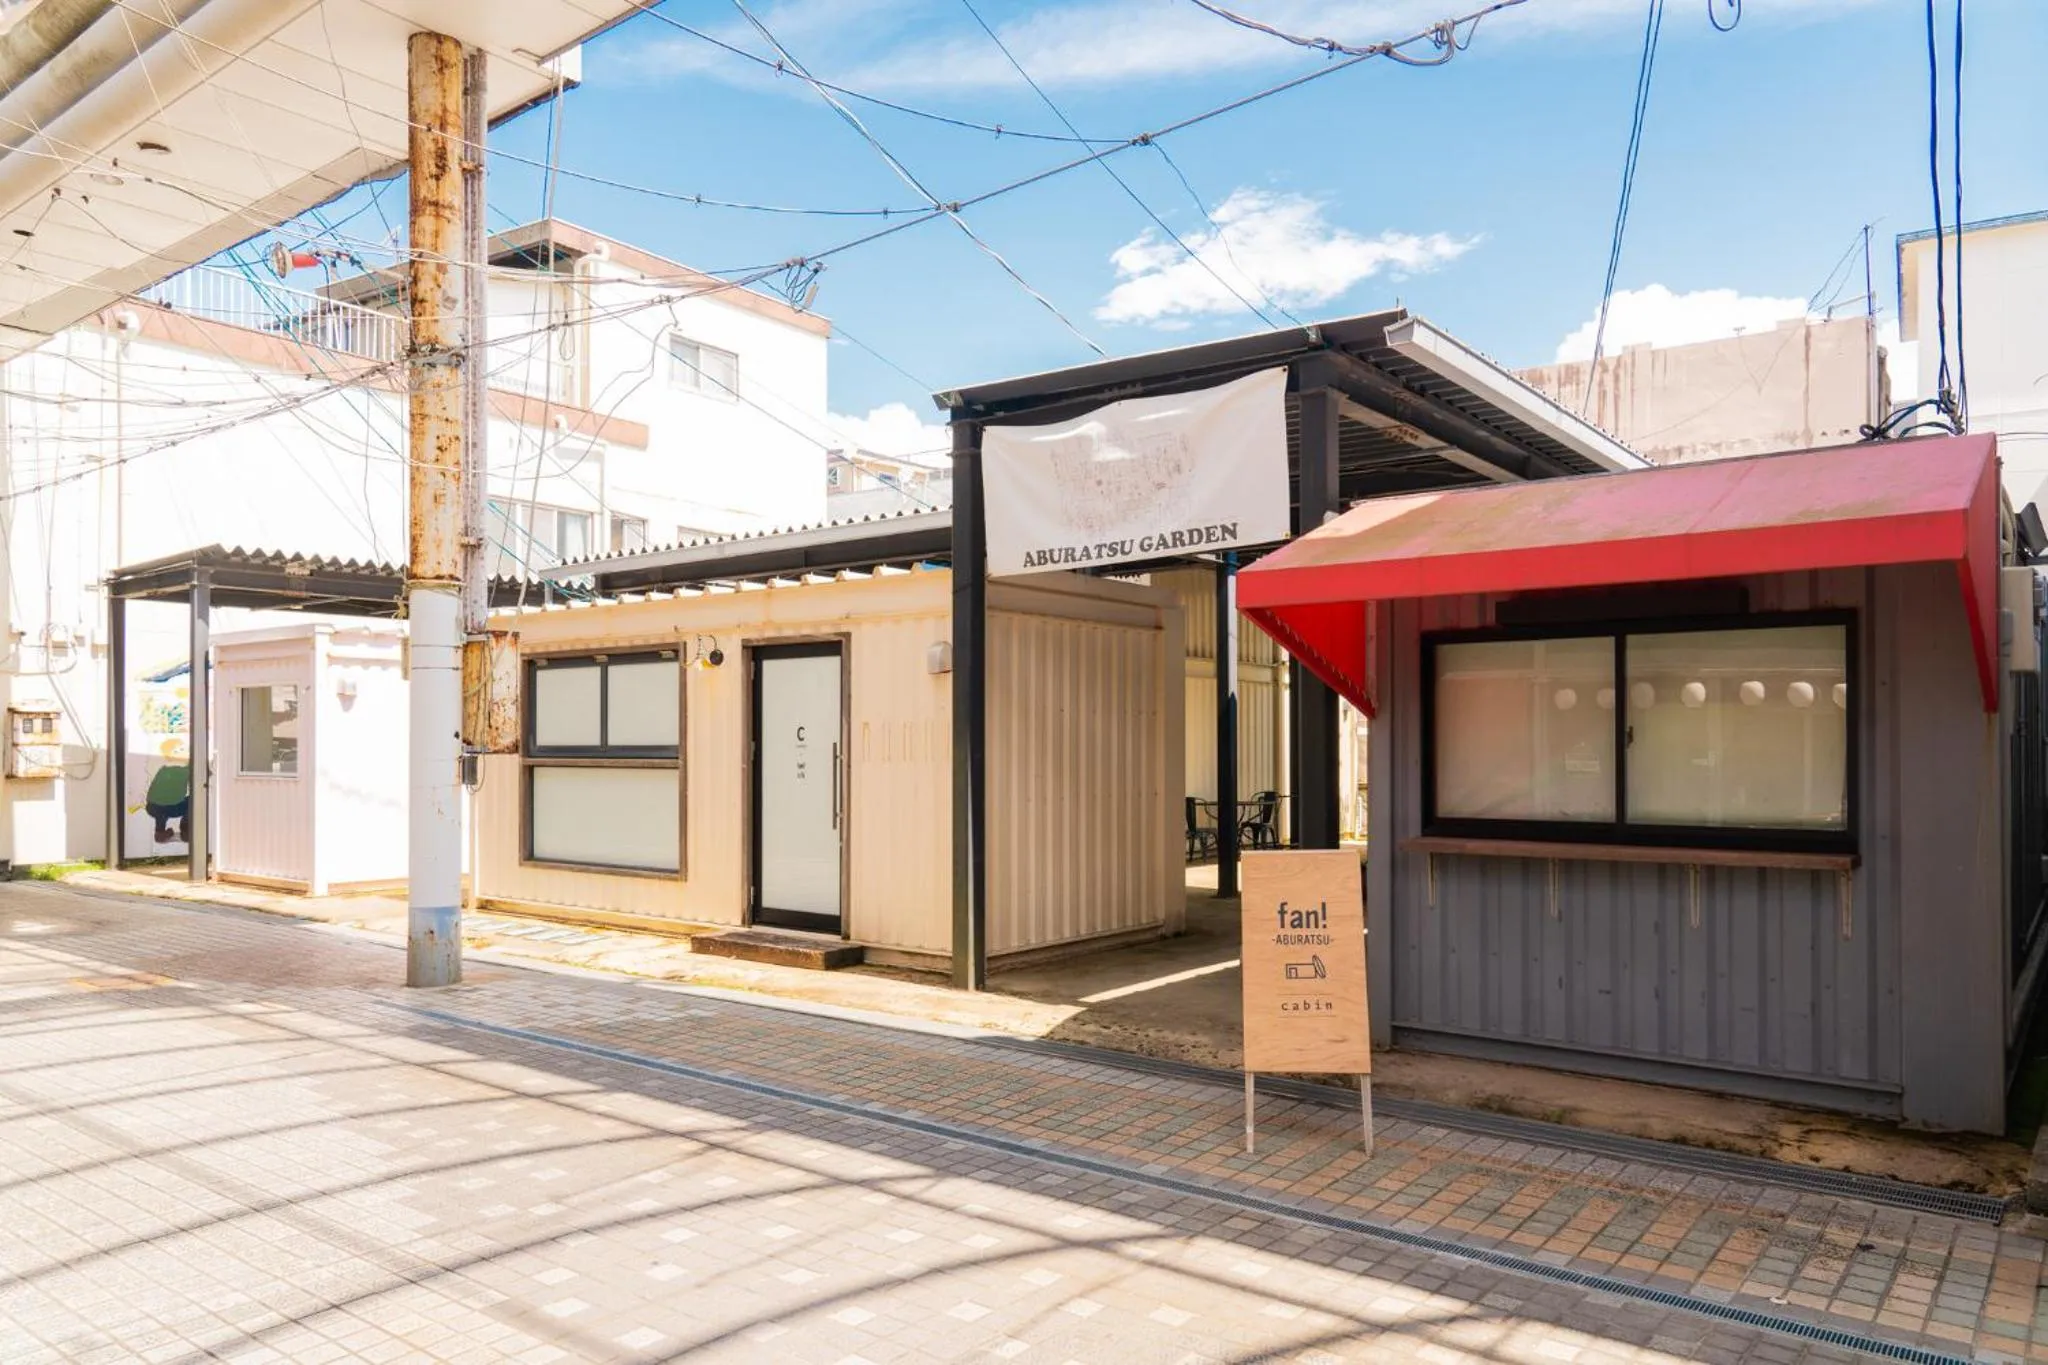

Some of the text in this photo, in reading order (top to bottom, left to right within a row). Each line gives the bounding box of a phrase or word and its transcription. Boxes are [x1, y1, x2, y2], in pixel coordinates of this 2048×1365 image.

[1023, 522, 1239, 568] ABURATSU GARDEN
[1278, 902, 1327, 929] fan!
[1281, 1000, 1333, 1011] cabin
